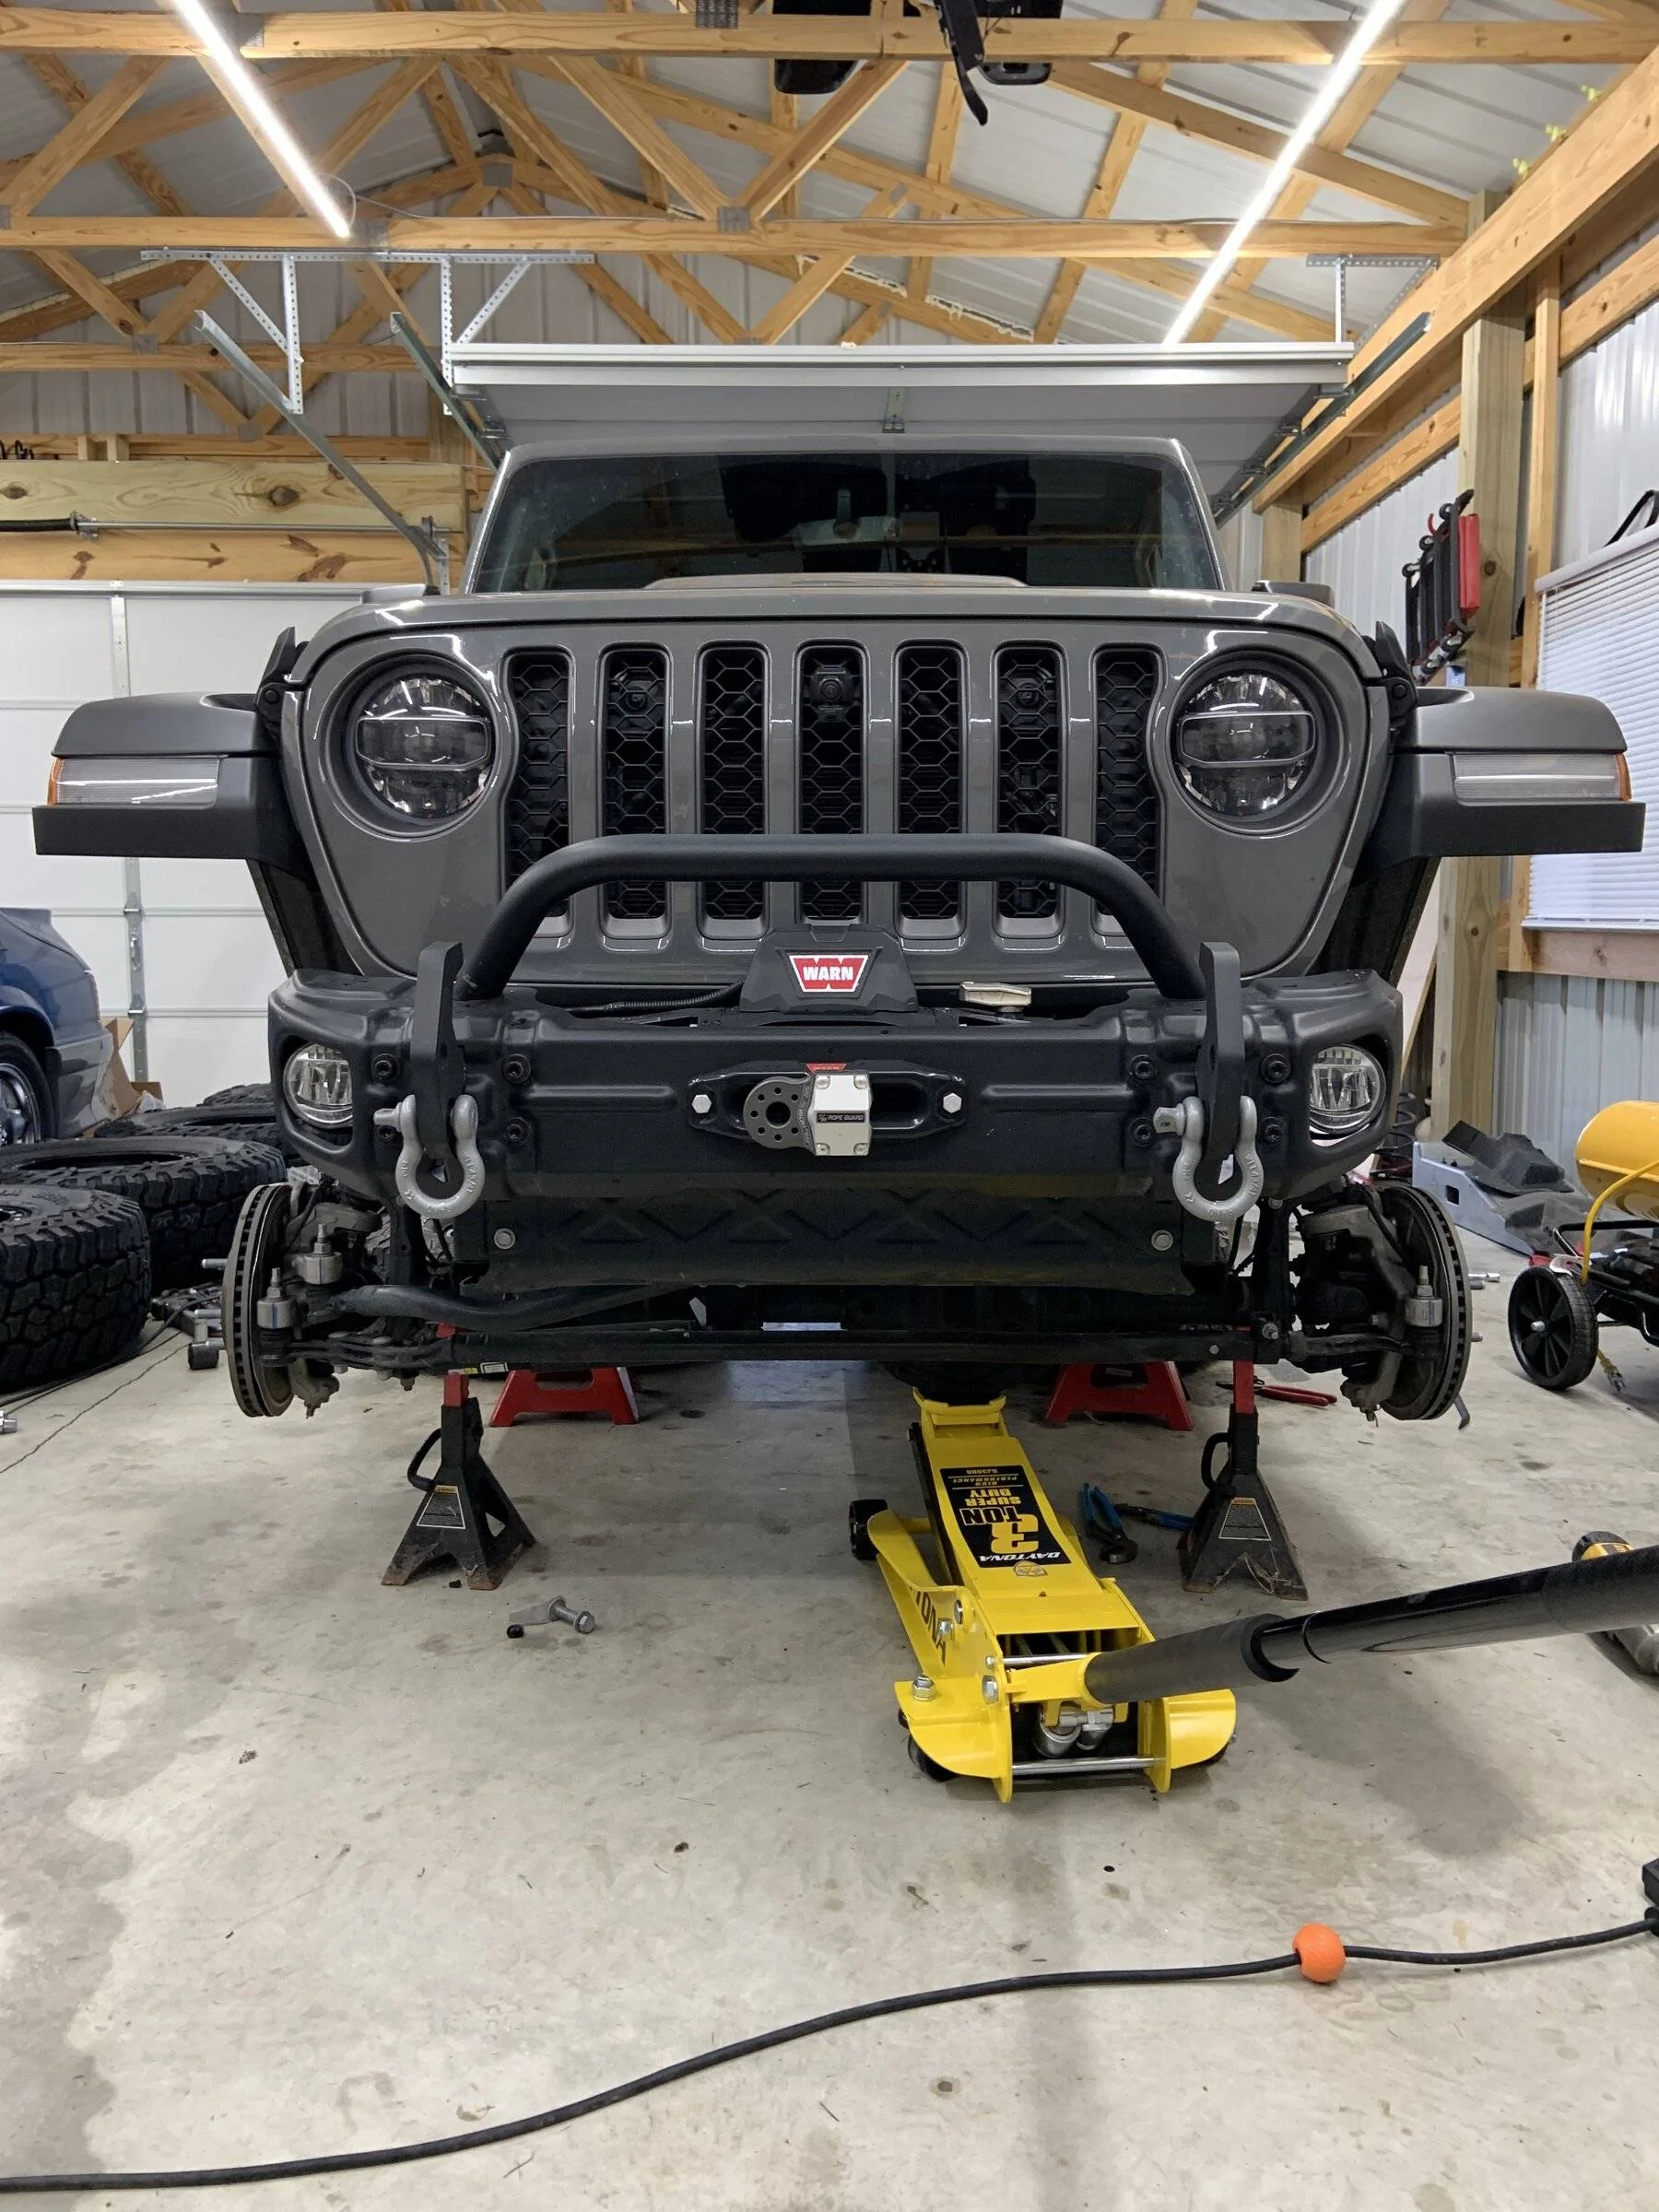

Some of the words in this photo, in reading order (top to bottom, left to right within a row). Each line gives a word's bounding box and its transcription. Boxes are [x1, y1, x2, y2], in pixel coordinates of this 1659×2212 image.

[803, 966, 854, 981] WARN
[970, 1488, 1012, 1498] DUTY
[964, 1496, 1022, 1507] SUPER
[959, 1505, 1022, 1526] TON
[991, 1513, 1039, 1555] 3
[979, 1552, 1061, 1562] DAYTONA
